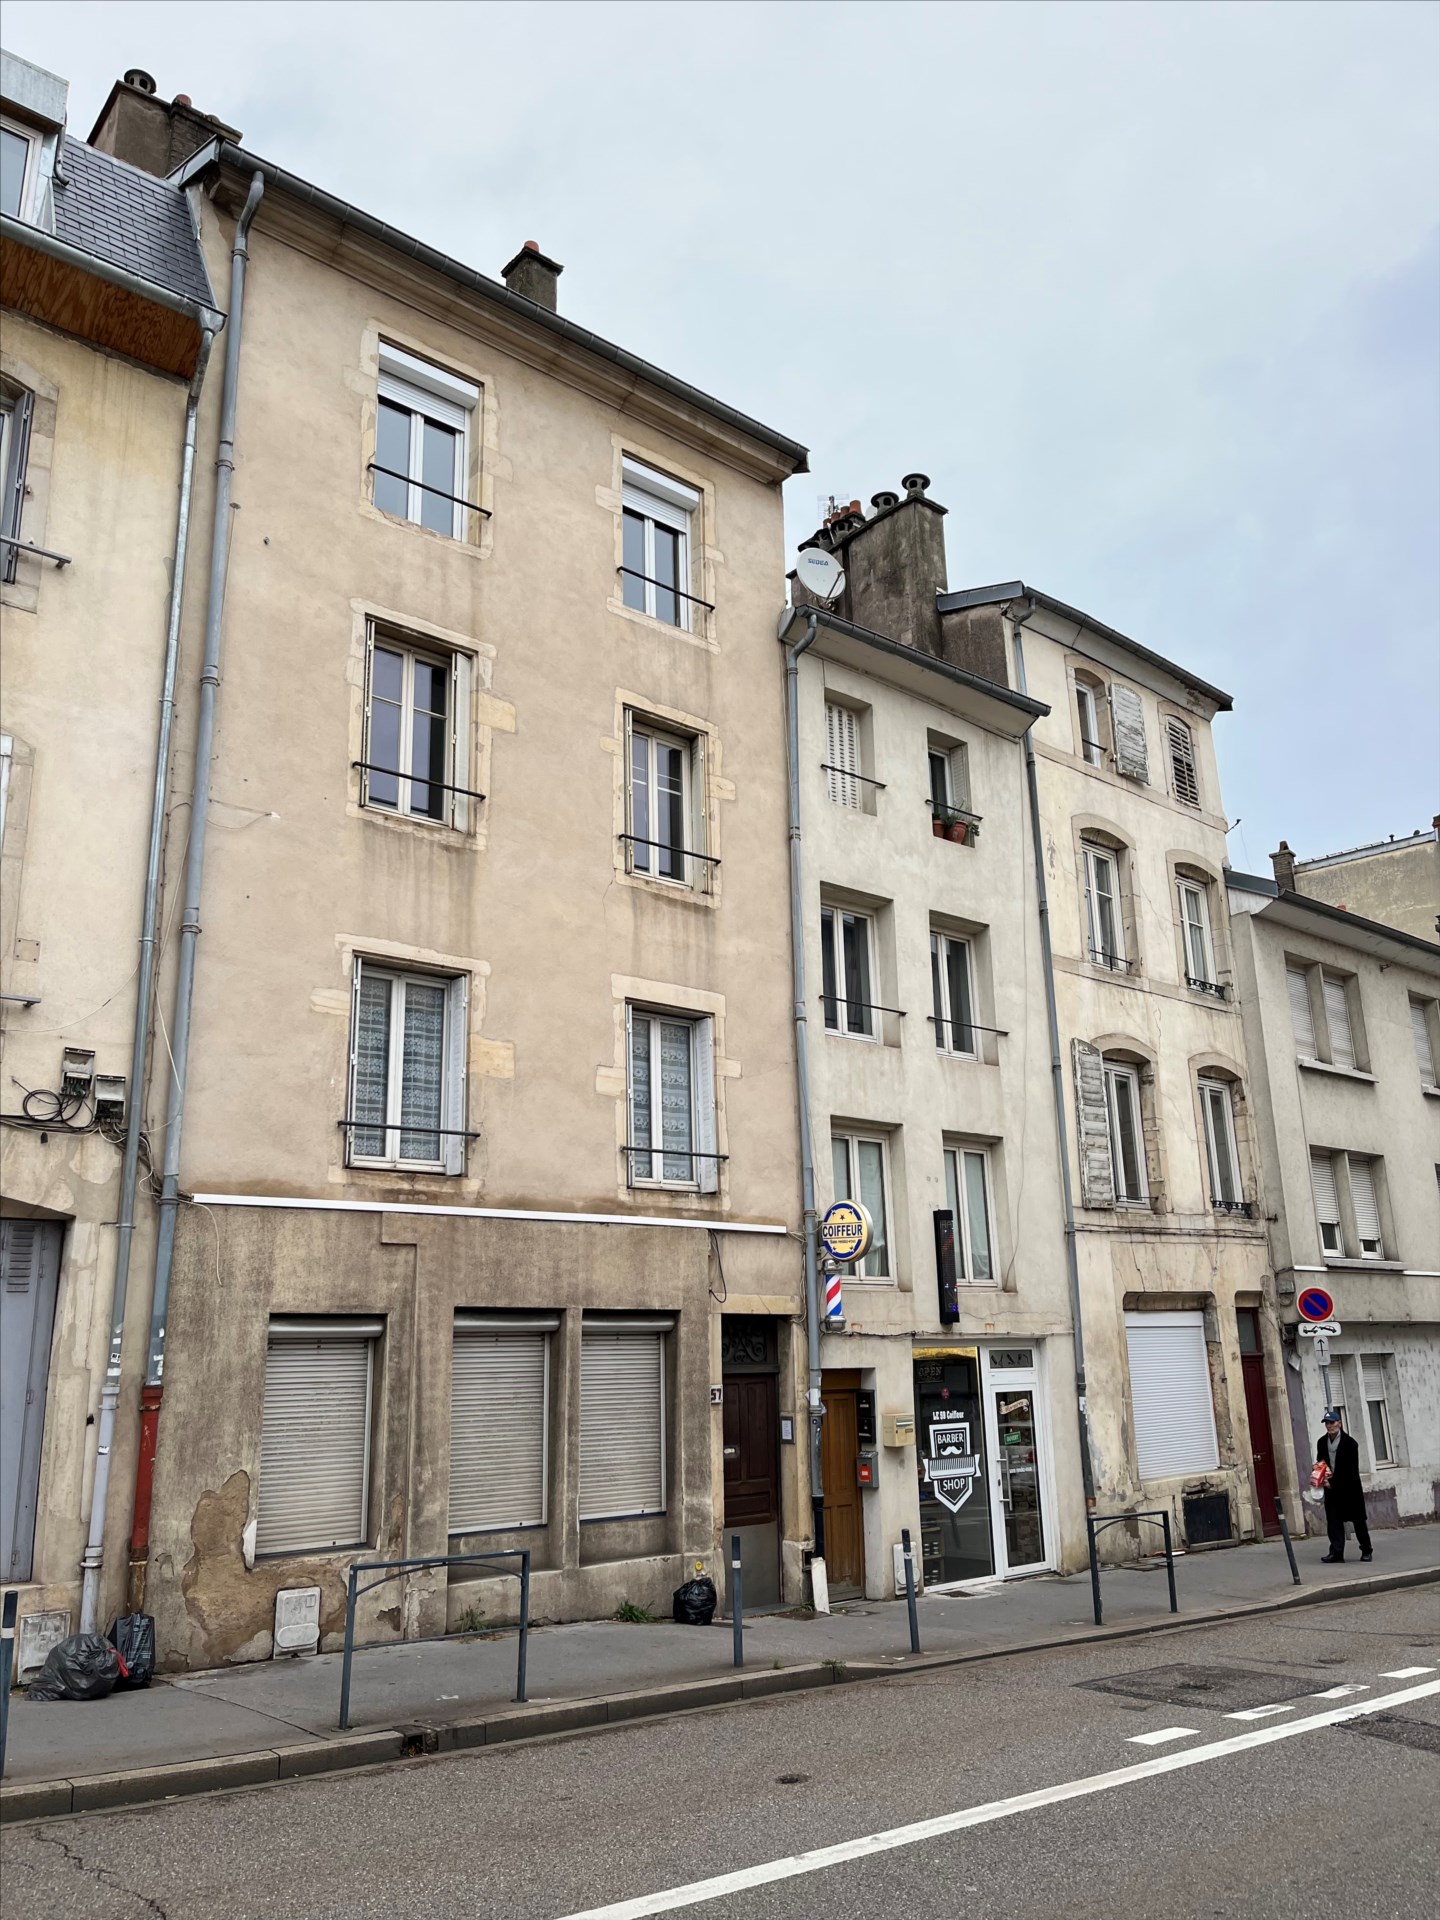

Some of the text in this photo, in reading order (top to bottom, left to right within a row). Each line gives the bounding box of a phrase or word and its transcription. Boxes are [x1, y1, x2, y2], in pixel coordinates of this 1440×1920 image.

[822, 1224, 863, 1237] COIFFEUR
[919, 1366, 943, 1377] OPEN
[710, 1388, 721, 1401] 57
[937, 1433, 964, 1444] BARBER
[942, 1479, 965, 1491] SHOP
